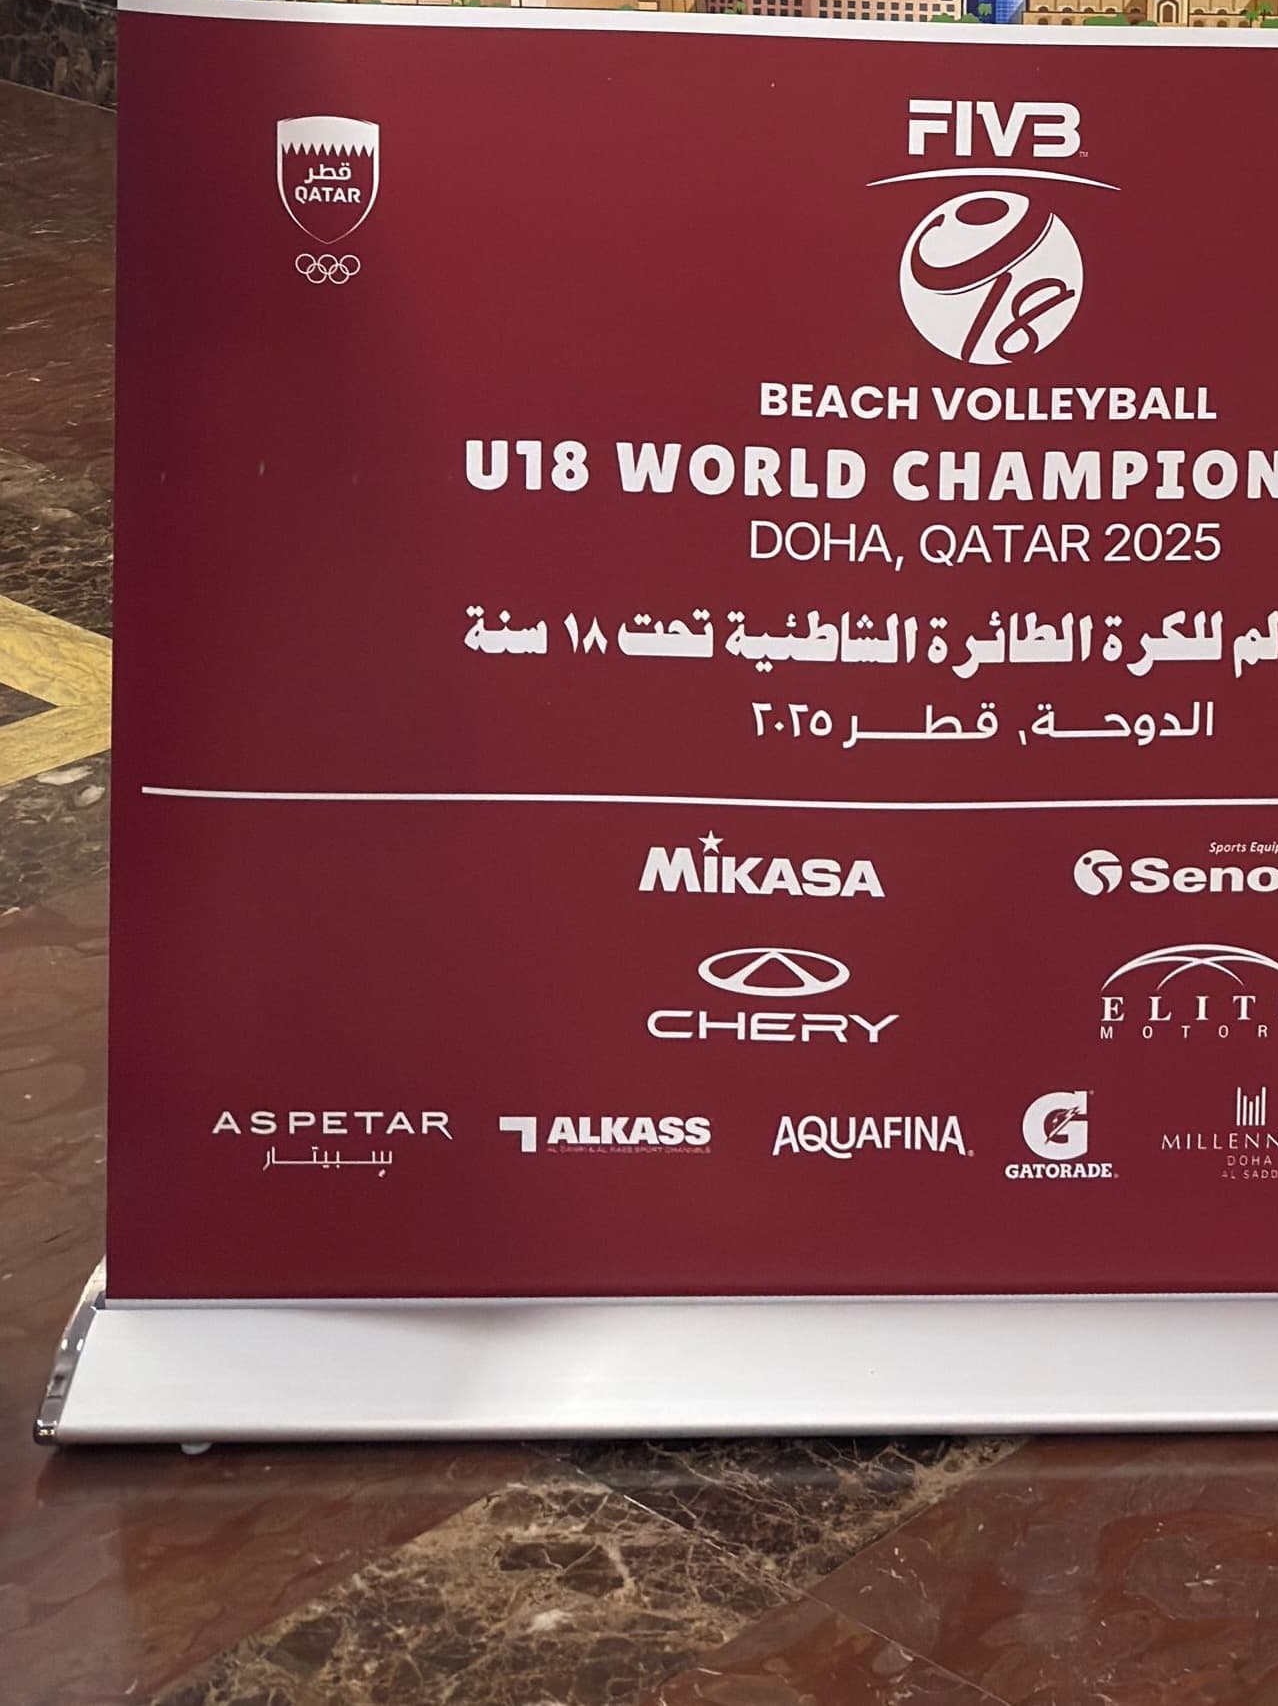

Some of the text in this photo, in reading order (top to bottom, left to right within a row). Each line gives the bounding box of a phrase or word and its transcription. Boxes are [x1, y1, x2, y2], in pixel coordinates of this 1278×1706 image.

[909, 100, 1081, 157] FIVB
[304, 162, 351, 184] قطر
[294, 185, 361, 204] QATAR
[760, 382, 1217, 421] BEACH VOLLEYBALL
[465, 439, 589, 492] U18
[615, 441, 866, 499] WORLD
[750, 520, 1221, 572] DOHA, QATAR 2025
[463, 605, 548, 655] سنة
[617, 608, 714, 658] تحت
[724, 610, 919, 673] الشاطئية
[927, 610, 1094, 679] الطائرة
[1102, 610, 1224, 677] للكرة
[1209, 841, 1247, 854] Sports
[646, 1009, 900, 1043] CHERY
[211, 1110, 453, 1140] ASPETAR
[546, 1116, 712, 1146] ALKASS
[772, 1115, 966, 1160] AQUAFINA
[1004, 1163, 1114, 1180] GATORADE
[1226, 1154, 1273, 1167] DOHA
